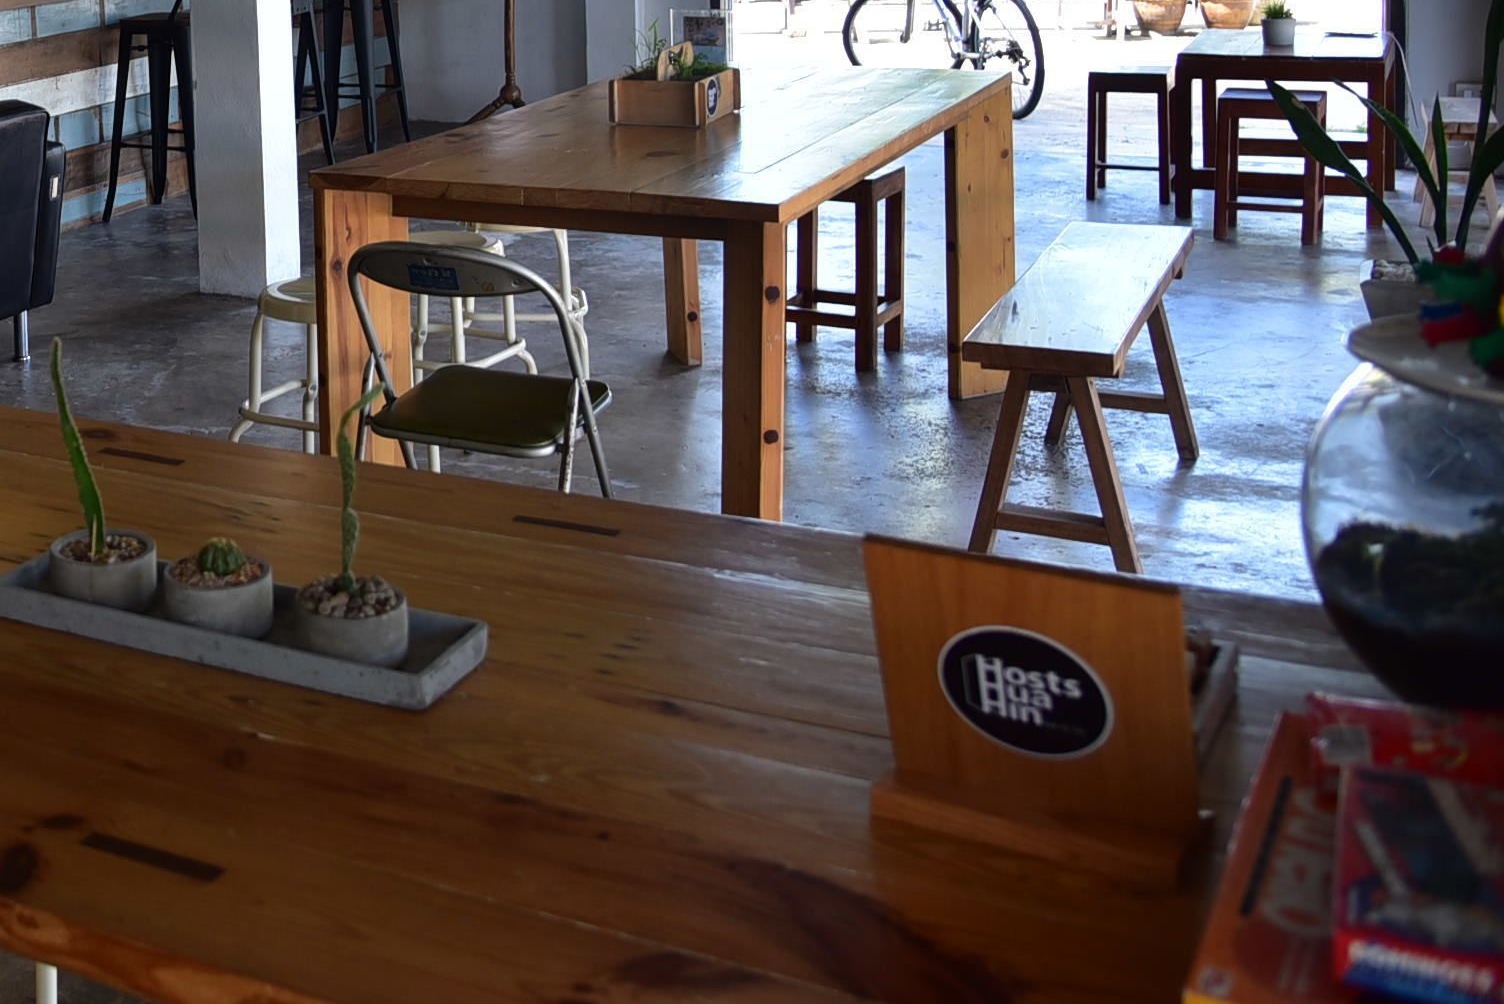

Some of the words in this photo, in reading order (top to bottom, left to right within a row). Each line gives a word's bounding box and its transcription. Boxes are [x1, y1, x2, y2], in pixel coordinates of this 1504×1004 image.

[976, 653, 1082, 698] Hosts
[978, 678, 1053, 710] Hua
[980, 694, 1045, 726] Hin
